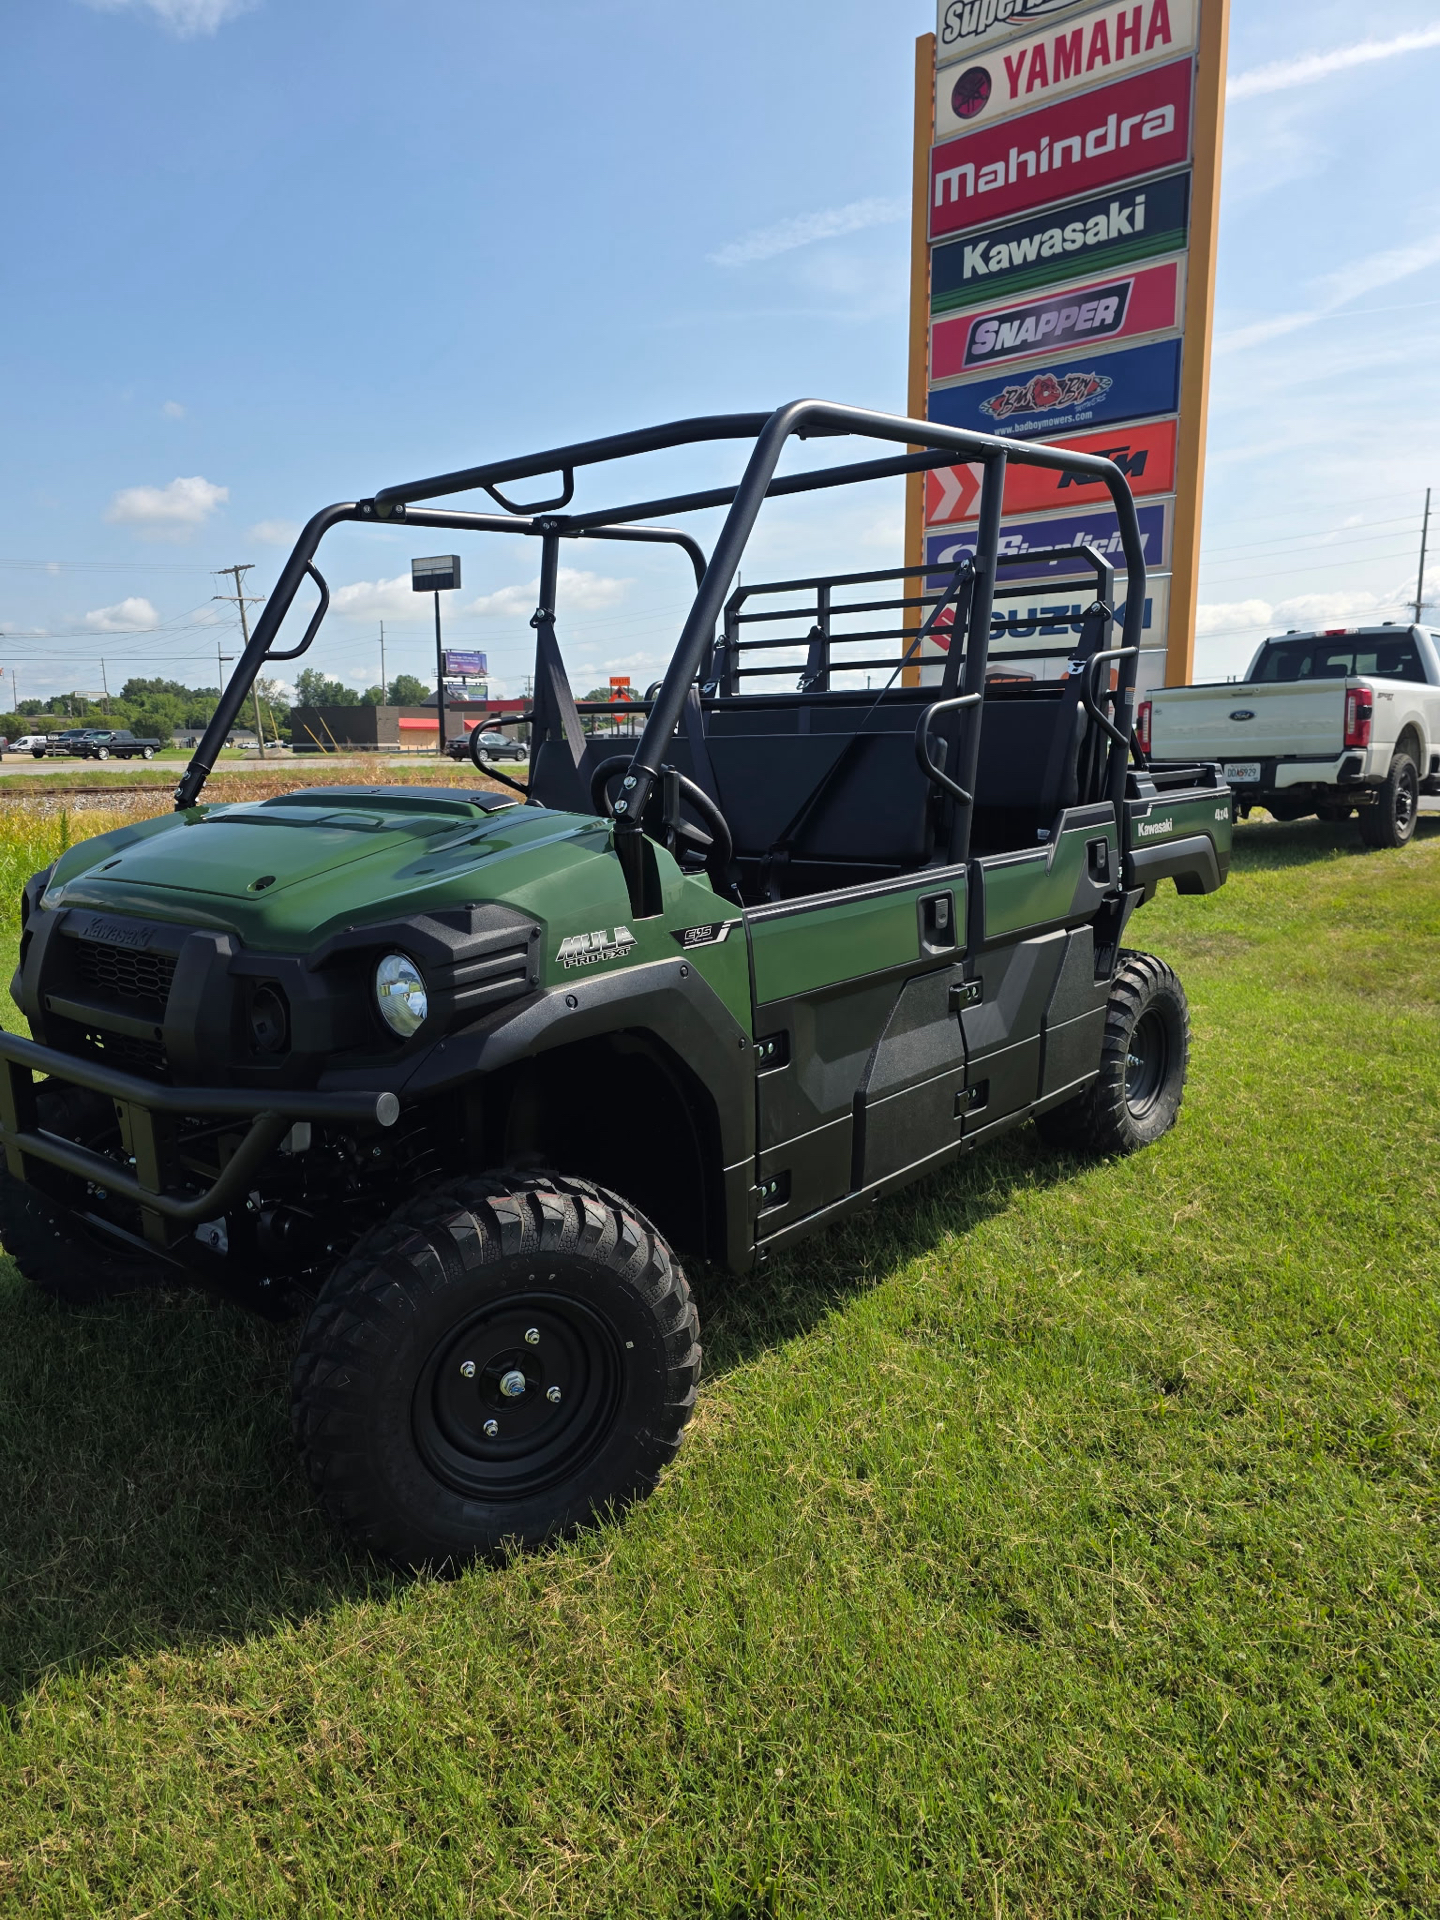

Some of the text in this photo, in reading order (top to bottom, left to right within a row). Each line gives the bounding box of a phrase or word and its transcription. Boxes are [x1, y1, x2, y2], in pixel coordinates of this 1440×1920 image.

[1003, 0, 1172, 99] YAMAHA
[934, 104, 1175, 208] Mahindra
[963, 194, 1146, 279] Kawasaki
[971, 296, 1119, 355] SNAPPER
[994, 411, 1093, 436] www.badboymowers.com
[1137, 818, 1173, 837] Kawasaki
[1214, 807, 1229, 821] 4x4
[82, 917, 157, 947] Kawasaki
[555, 926, 638, 962] MULE
[684, 925, 712, 940] EPS
[564, 945, 631, 969] PRO-FXT
